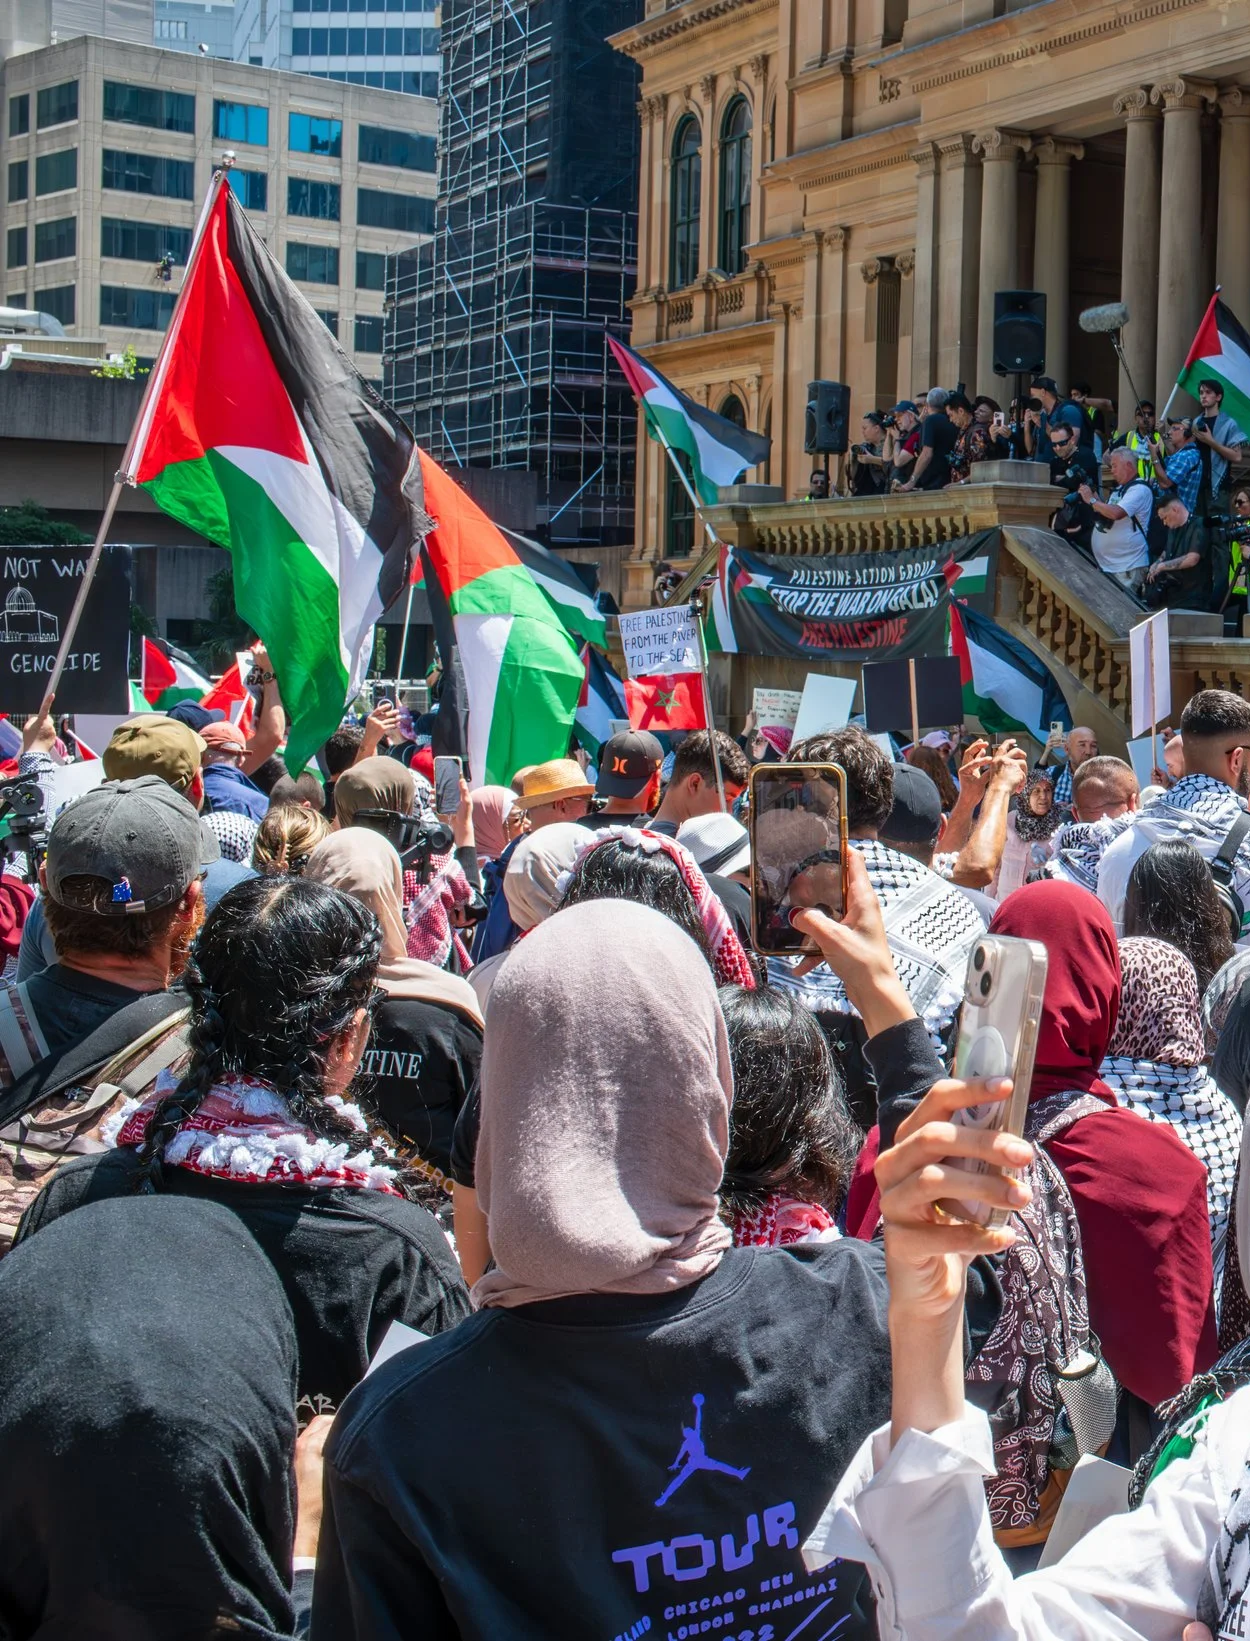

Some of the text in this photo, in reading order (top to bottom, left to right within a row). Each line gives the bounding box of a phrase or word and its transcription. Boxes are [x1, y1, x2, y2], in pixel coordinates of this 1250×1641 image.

[4, 556, 97, 579] NOT WA
[789, 560, 937, 586] PALESTINE ACTION GROUP
[770, 580, 939, 616] STOP THE WAR ON GAZA!
[620, 610, 692, 634] FREE PALESTINE
[798, 618, 909, 649] FREE PALESTINE
[624, 628, 697, 651] FROM THE RIVER
[10, 653, 102, 673] GENOIDE
[630, 648, 690, 668] TO THE SEA
[612, 1501, 799, 1592] TOUR
[663, 1572, 794, 1620] CHICAGO NEW
[667, 1578, 838, 1641] LONDON SHANGHAI
[1222, 1599, 1249, 1638] EE
